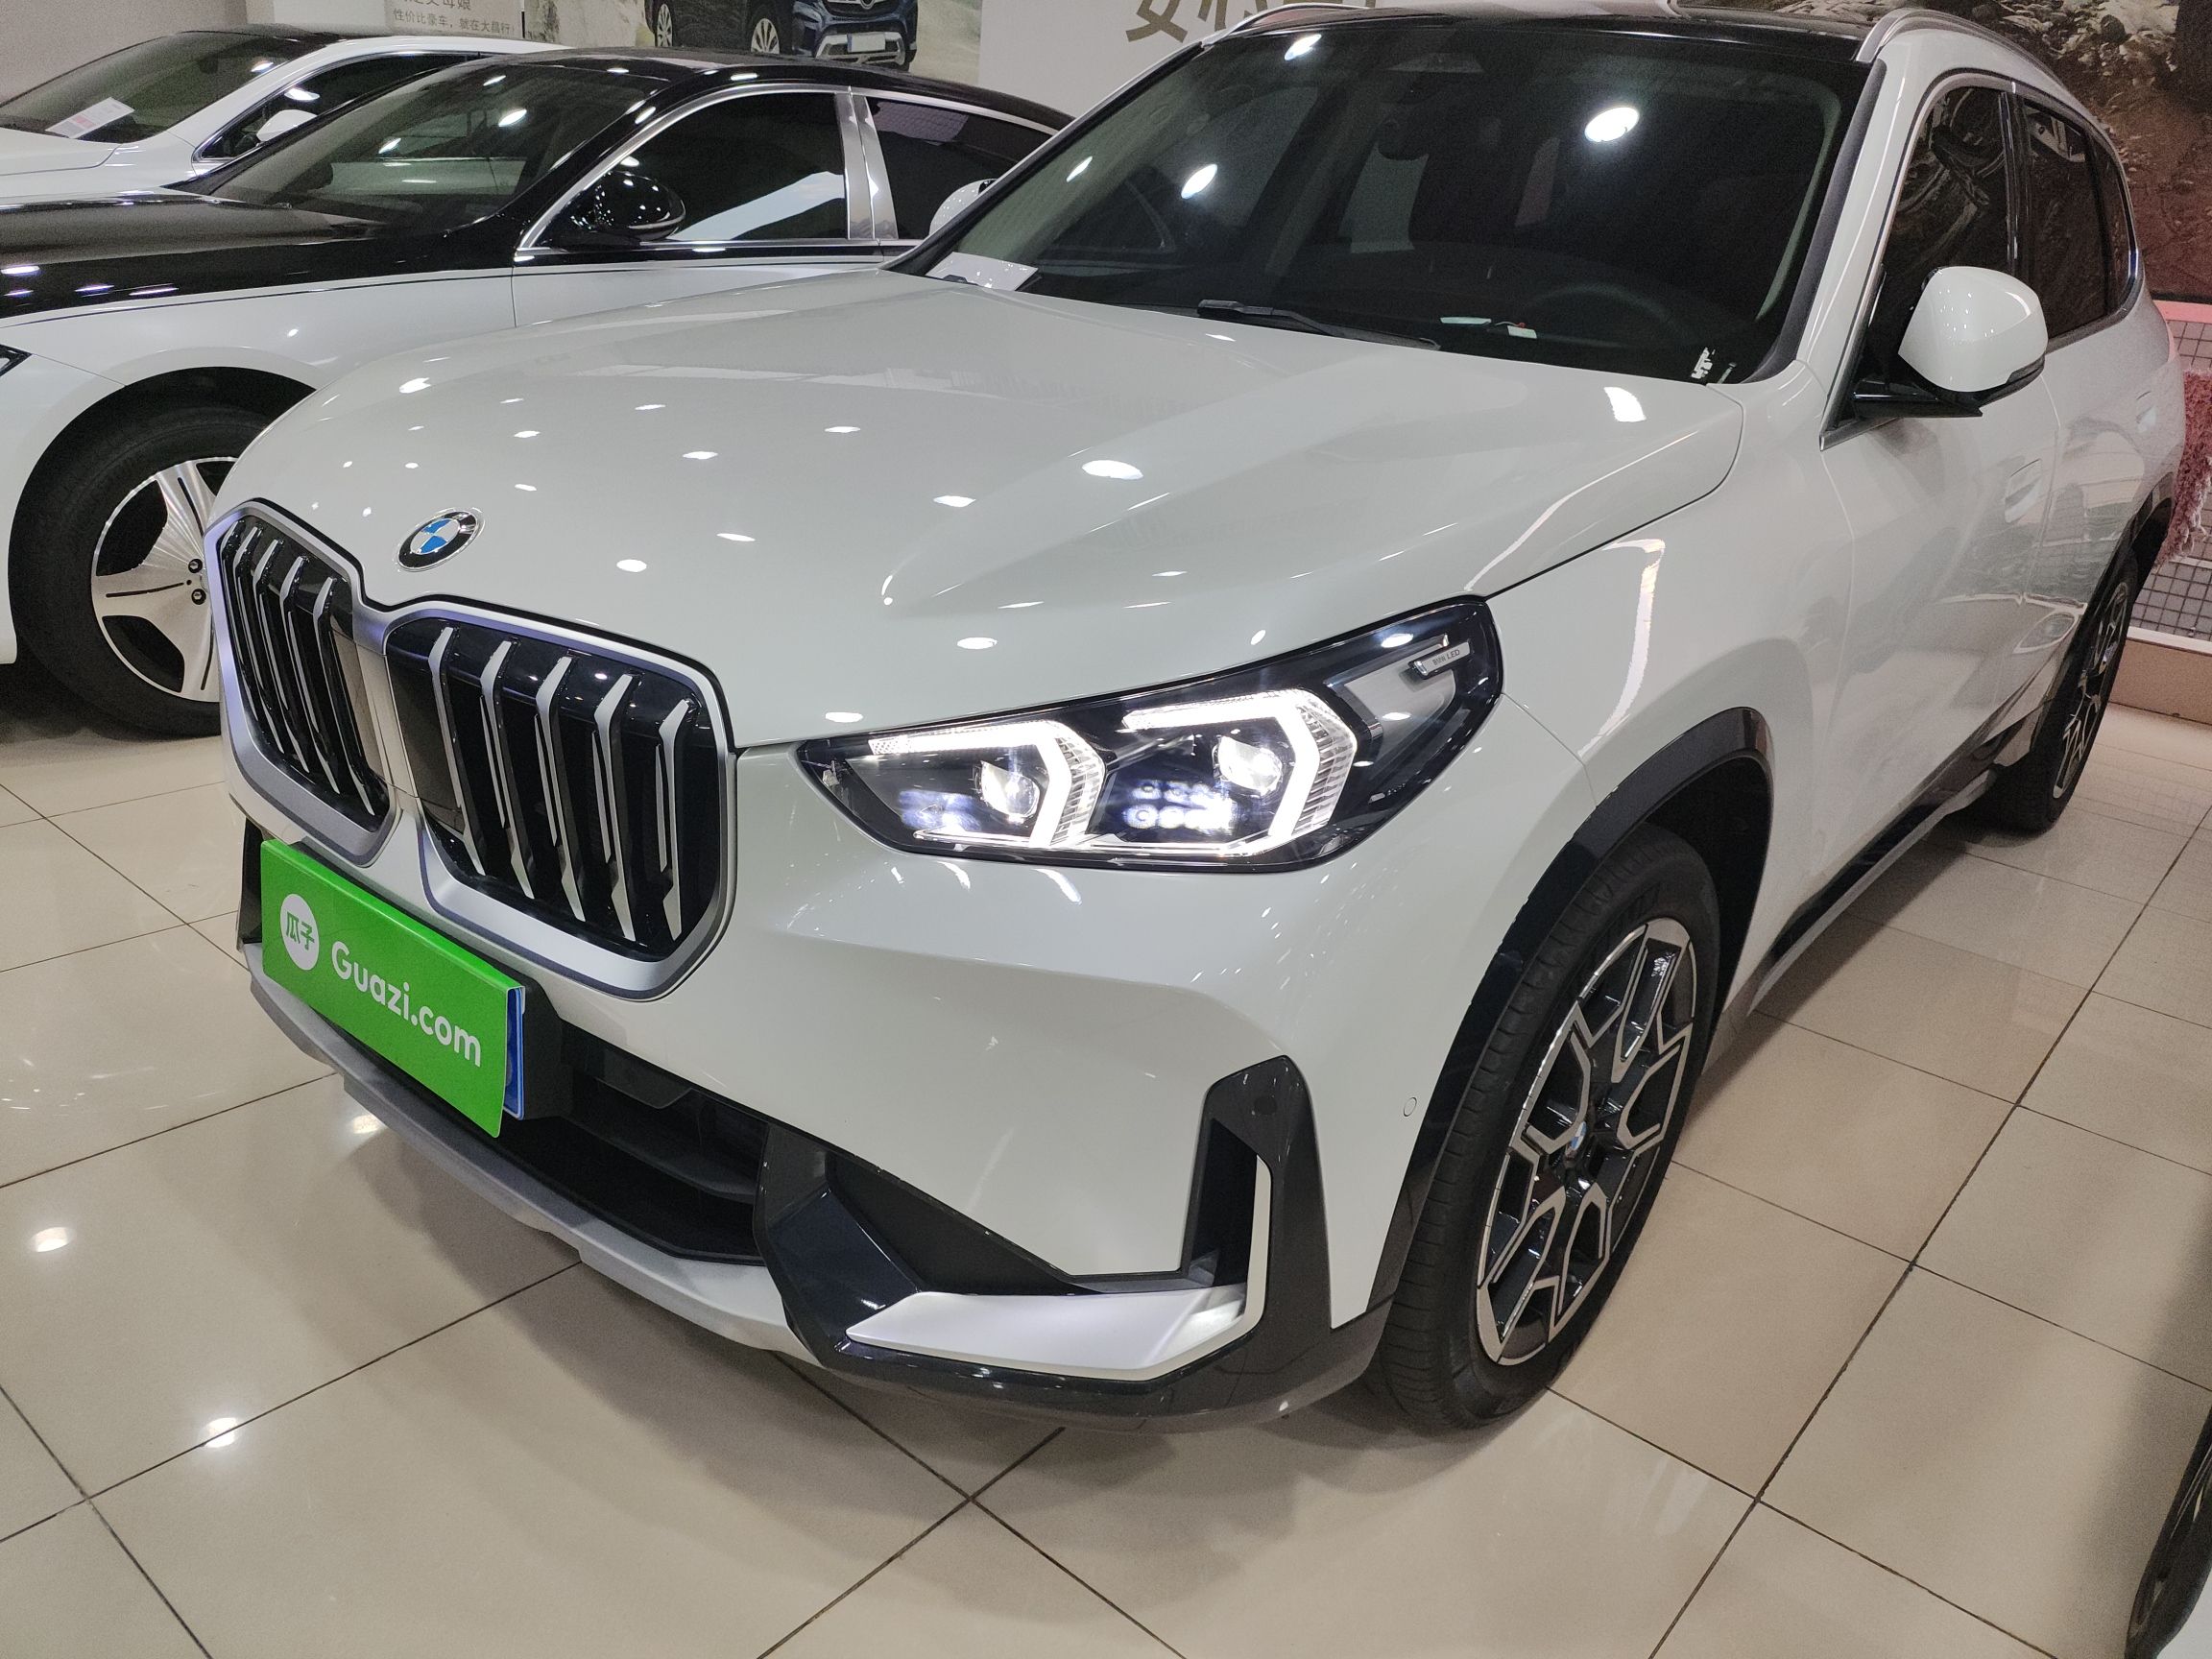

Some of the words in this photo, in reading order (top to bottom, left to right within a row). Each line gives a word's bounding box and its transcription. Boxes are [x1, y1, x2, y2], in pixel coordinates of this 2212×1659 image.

[1446, 649, 1460, 660] LED
[286, 912, 315, 950] 瓜子
[331, 941, 481, 1068] Guazi.com
